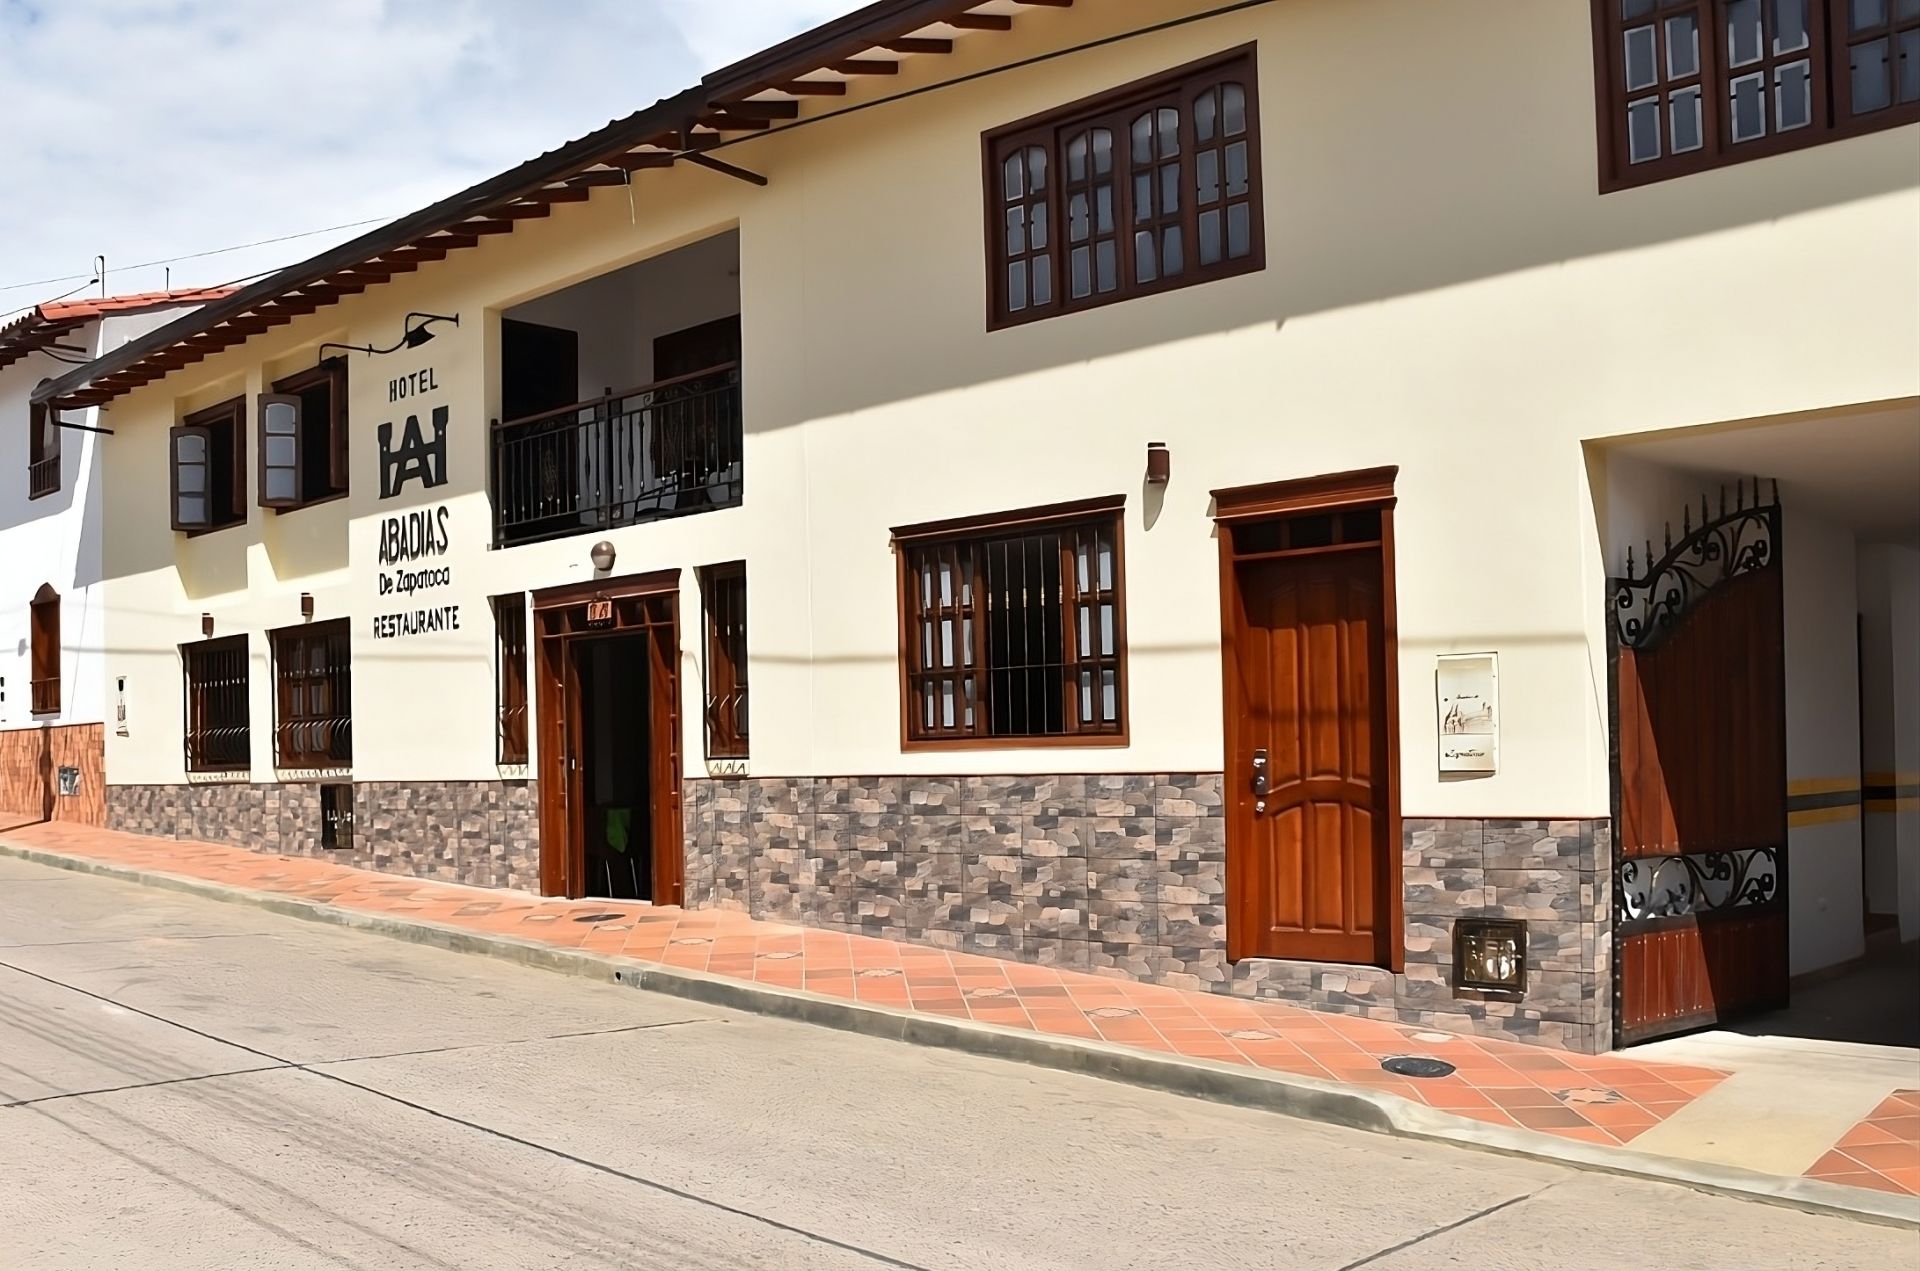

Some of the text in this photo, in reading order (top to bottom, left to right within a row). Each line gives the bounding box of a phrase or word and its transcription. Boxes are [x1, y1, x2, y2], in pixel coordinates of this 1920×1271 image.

[389, 367, 439, 403] HOTEL
[378, 506, 449, 567] ABADIAS
[379, 566, 450, 597] De Zapatoca
[373, 605, 460, 639] RESTAURANTE
